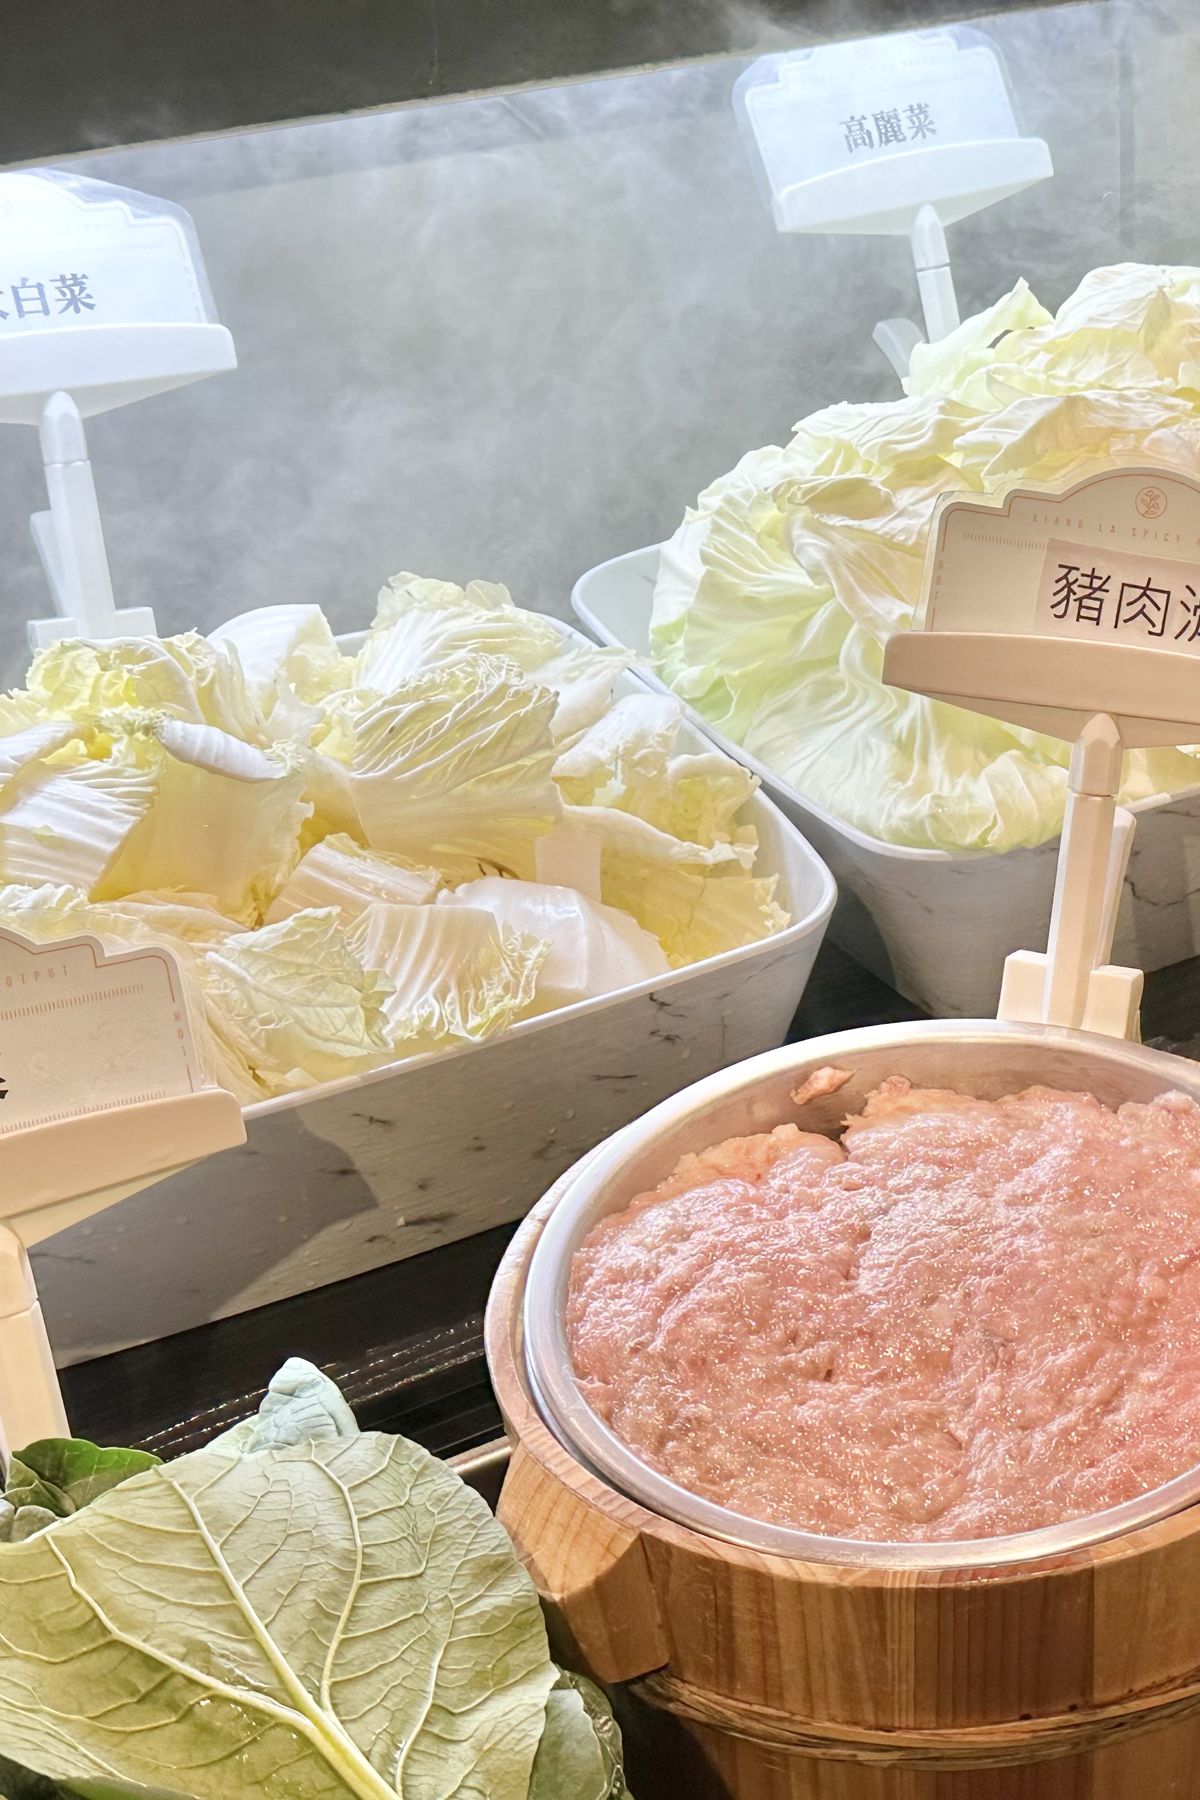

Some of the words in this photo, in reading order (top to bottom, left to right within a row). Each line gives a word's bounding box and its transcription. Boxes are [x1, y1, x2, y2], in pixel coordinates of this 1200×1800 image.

[840, 103, 937, 153] 高麗菜
[0, 273, 96, 320] 白菜
[5, 964, 69, 988] OTPOT
